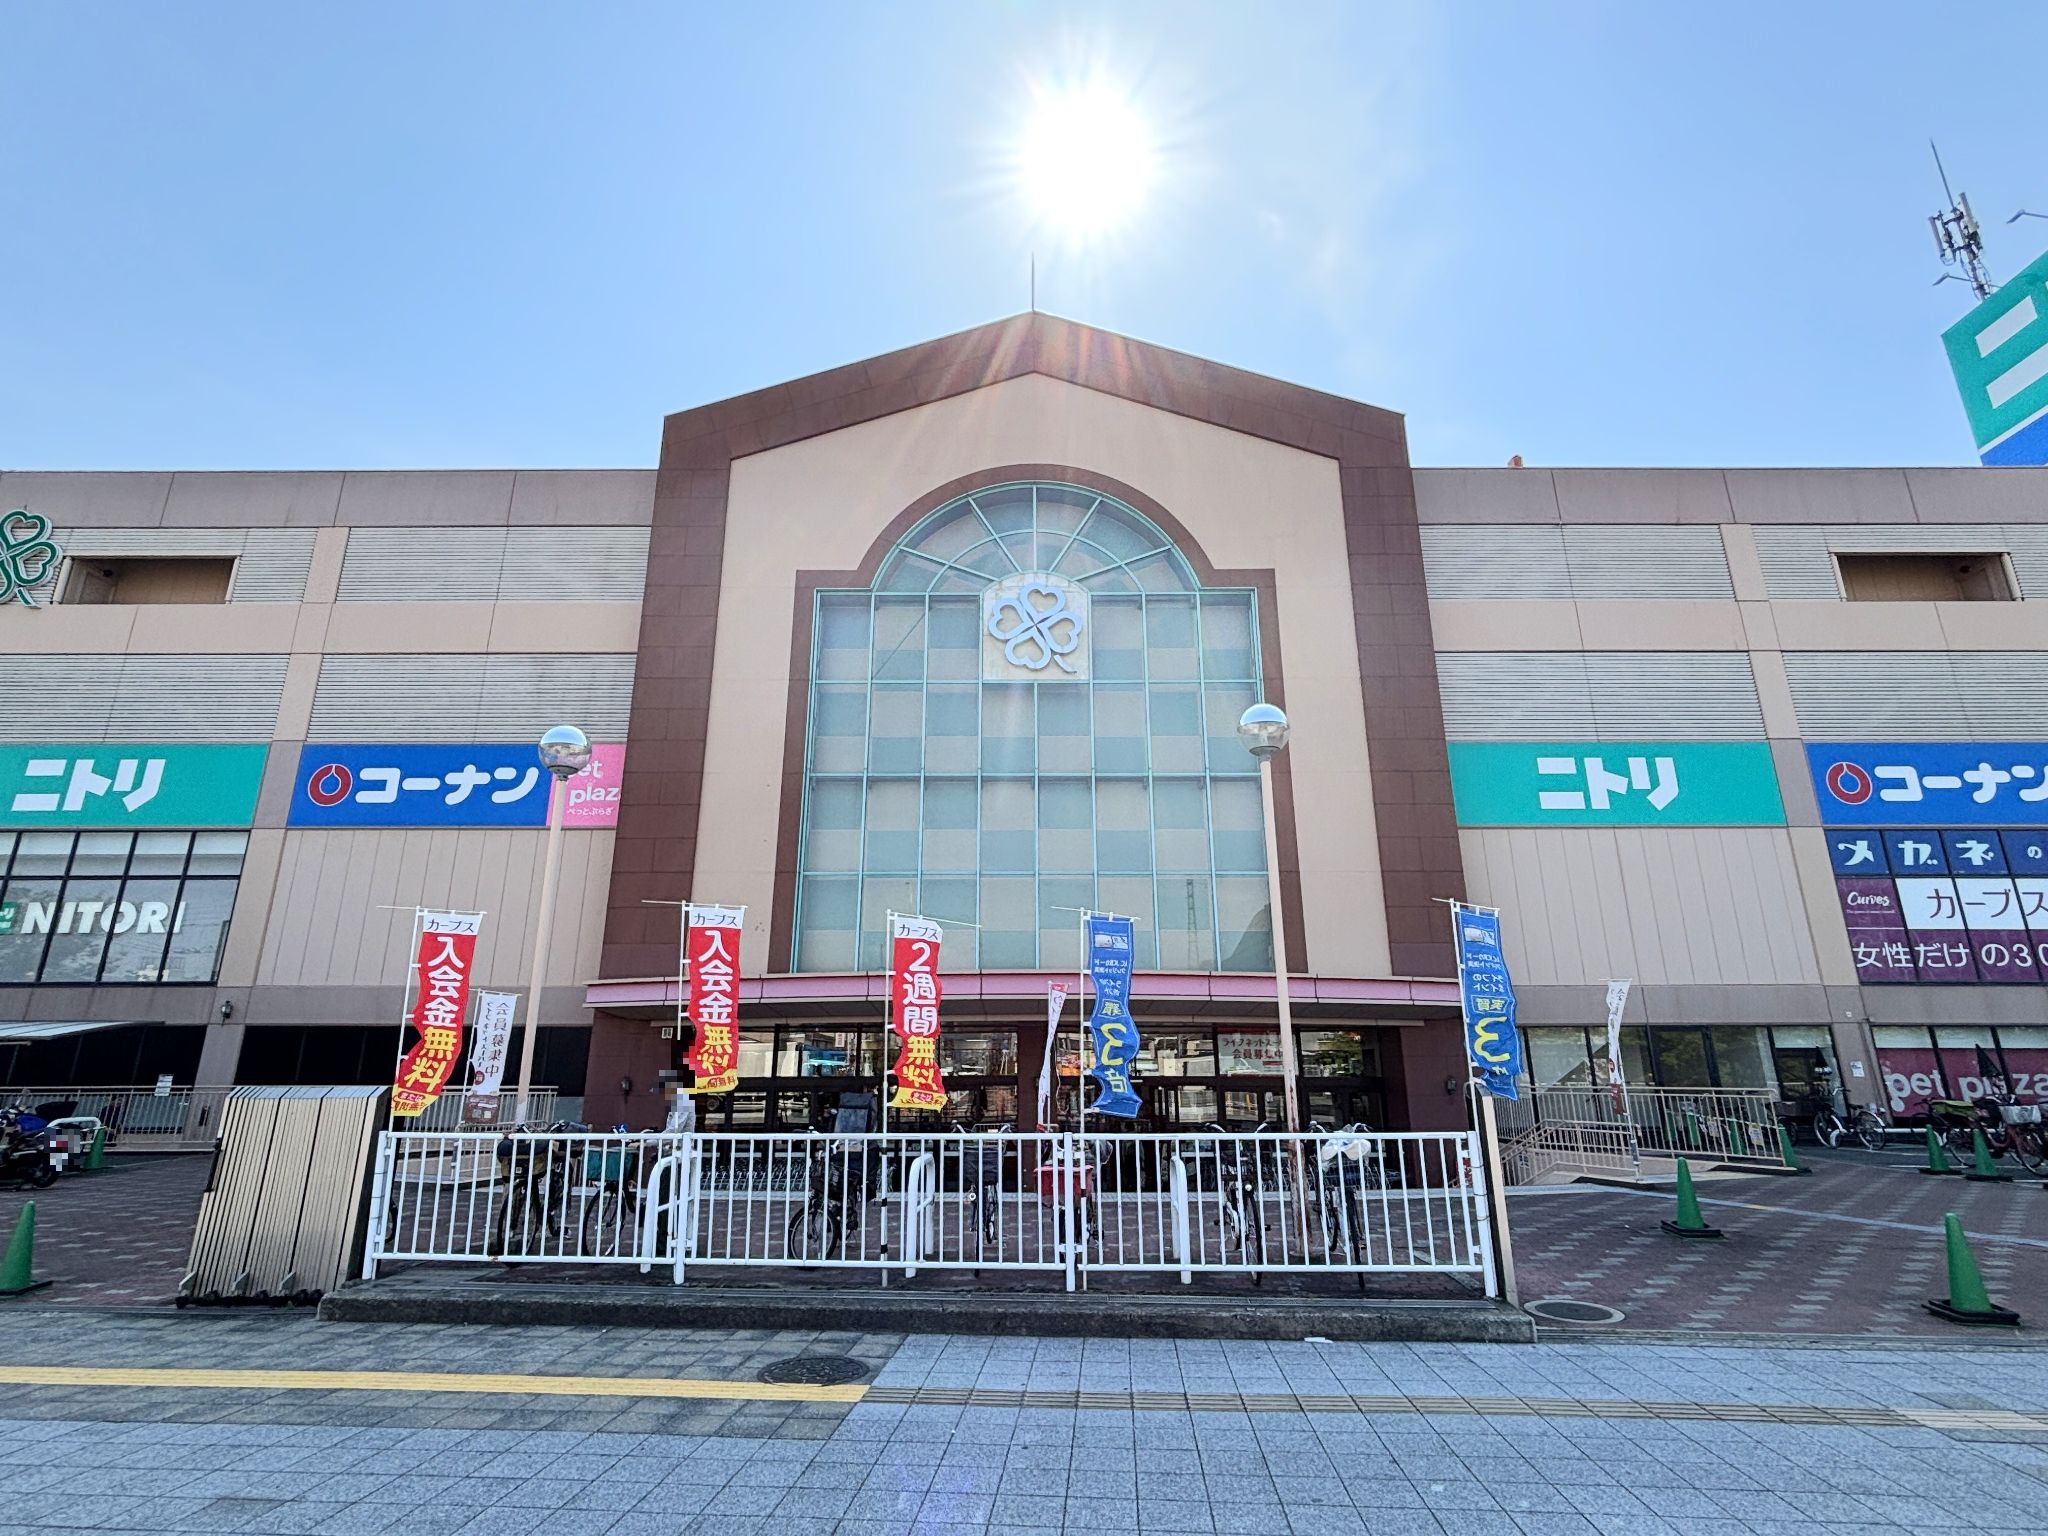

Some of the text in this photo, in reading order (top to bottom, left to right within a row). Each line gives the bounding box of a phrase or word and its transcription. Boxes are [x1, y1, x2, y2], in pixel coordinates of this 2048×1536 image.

[1975, 281, 2048, 409] ニ
[11, 759, 166, 812] ニトリ
[355, 764, 539, 805] コーナン
[567, 761, 603, 785] et
[1537, 757, 1679, 811] ニトリ
[1874, 762, 2048, 804] コーナン
[569, 783, 621, 806] plaz
[1847, 891, 1890, 906] Curves
[1927, 888, 2048, 919] カーブス
[20, 901, 186, 934] NITORI
[427, 919, 474, 933] カーブス
[693, 912, 738, 927] カーブス
[898, 924, 939, 940] カーブス
[403, 936, 465, 1092] 入会金無料
[903, 942, 938, 1091] 2週間無料
[1223, 1038, 1281, 1047] ライフネットスー
[1884, 1069, 1946, 1112] pet
